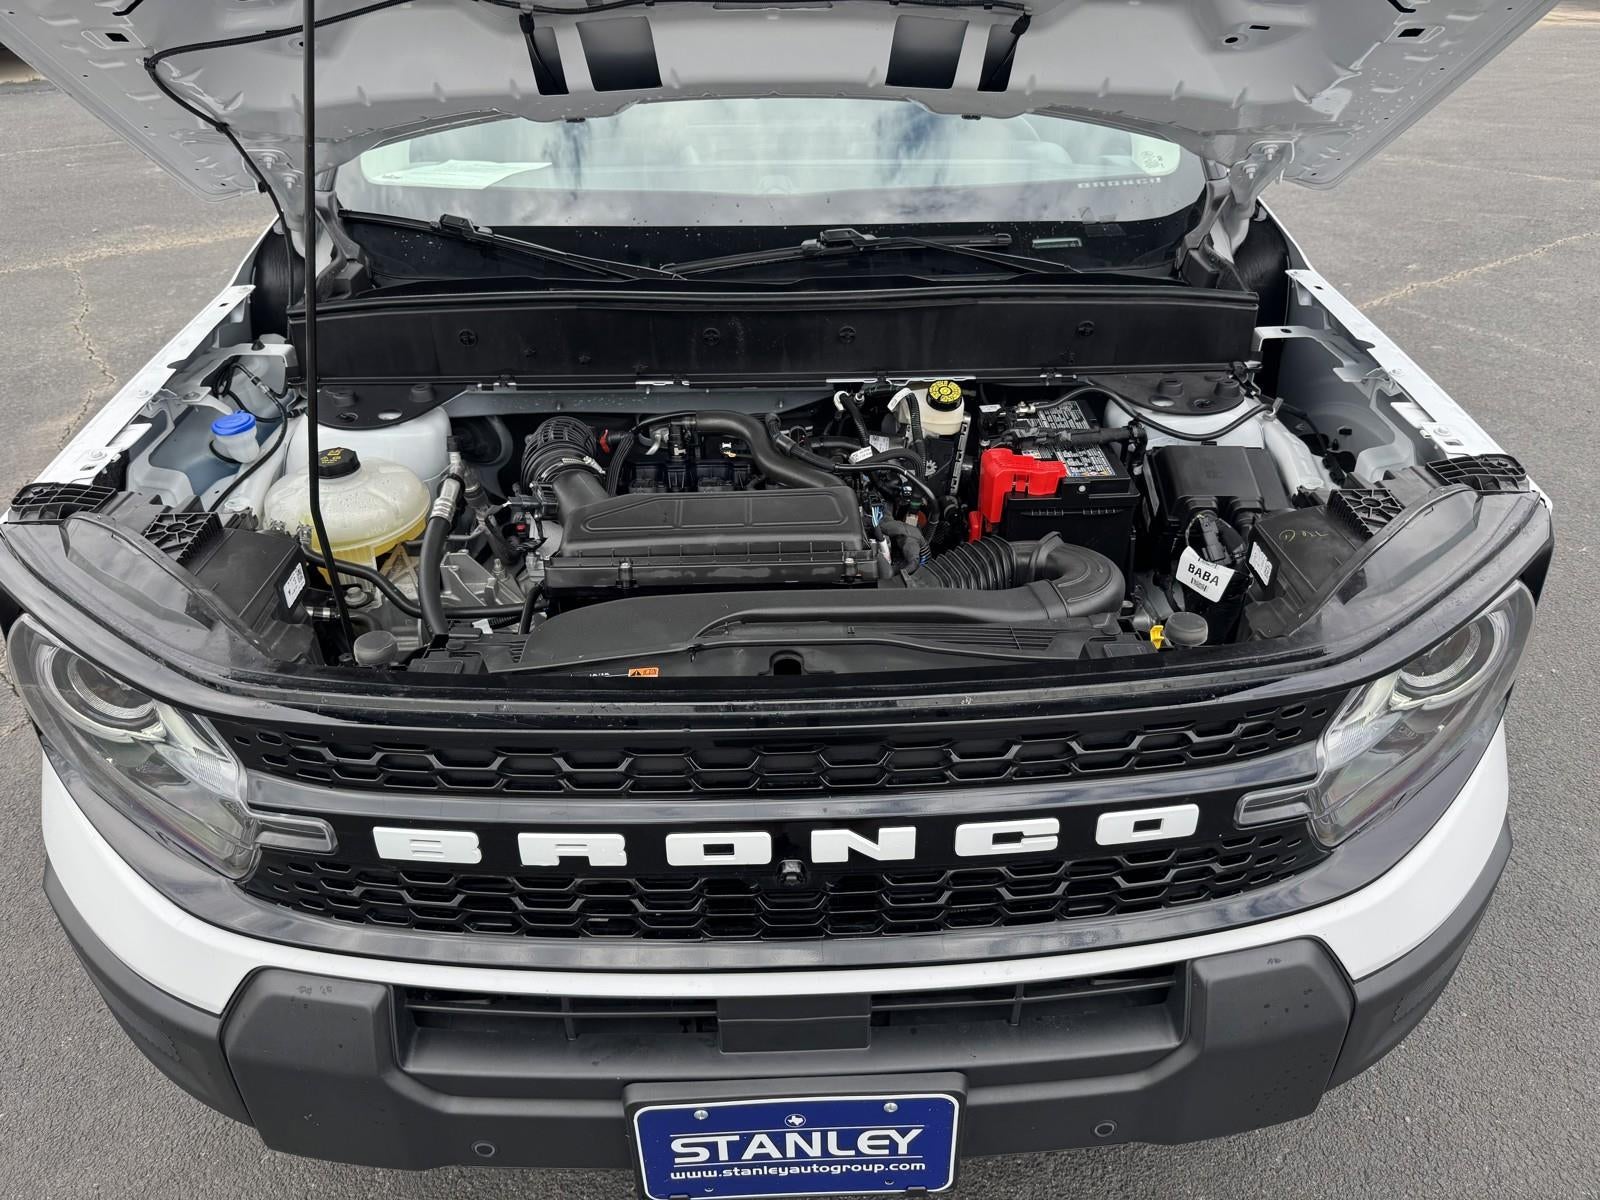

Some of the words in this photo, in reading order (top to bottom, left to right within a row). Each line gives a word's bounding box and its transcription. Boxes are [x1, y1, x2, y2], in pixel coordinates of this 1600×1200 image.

[1187, 563, 1220, 586] BABA
[373, 803, 1199, 867] BRONCO
[671, 1128, 923, 1163] STANLEY
[671, 1162, 926, 1180] www.stanleyautogroup.com
